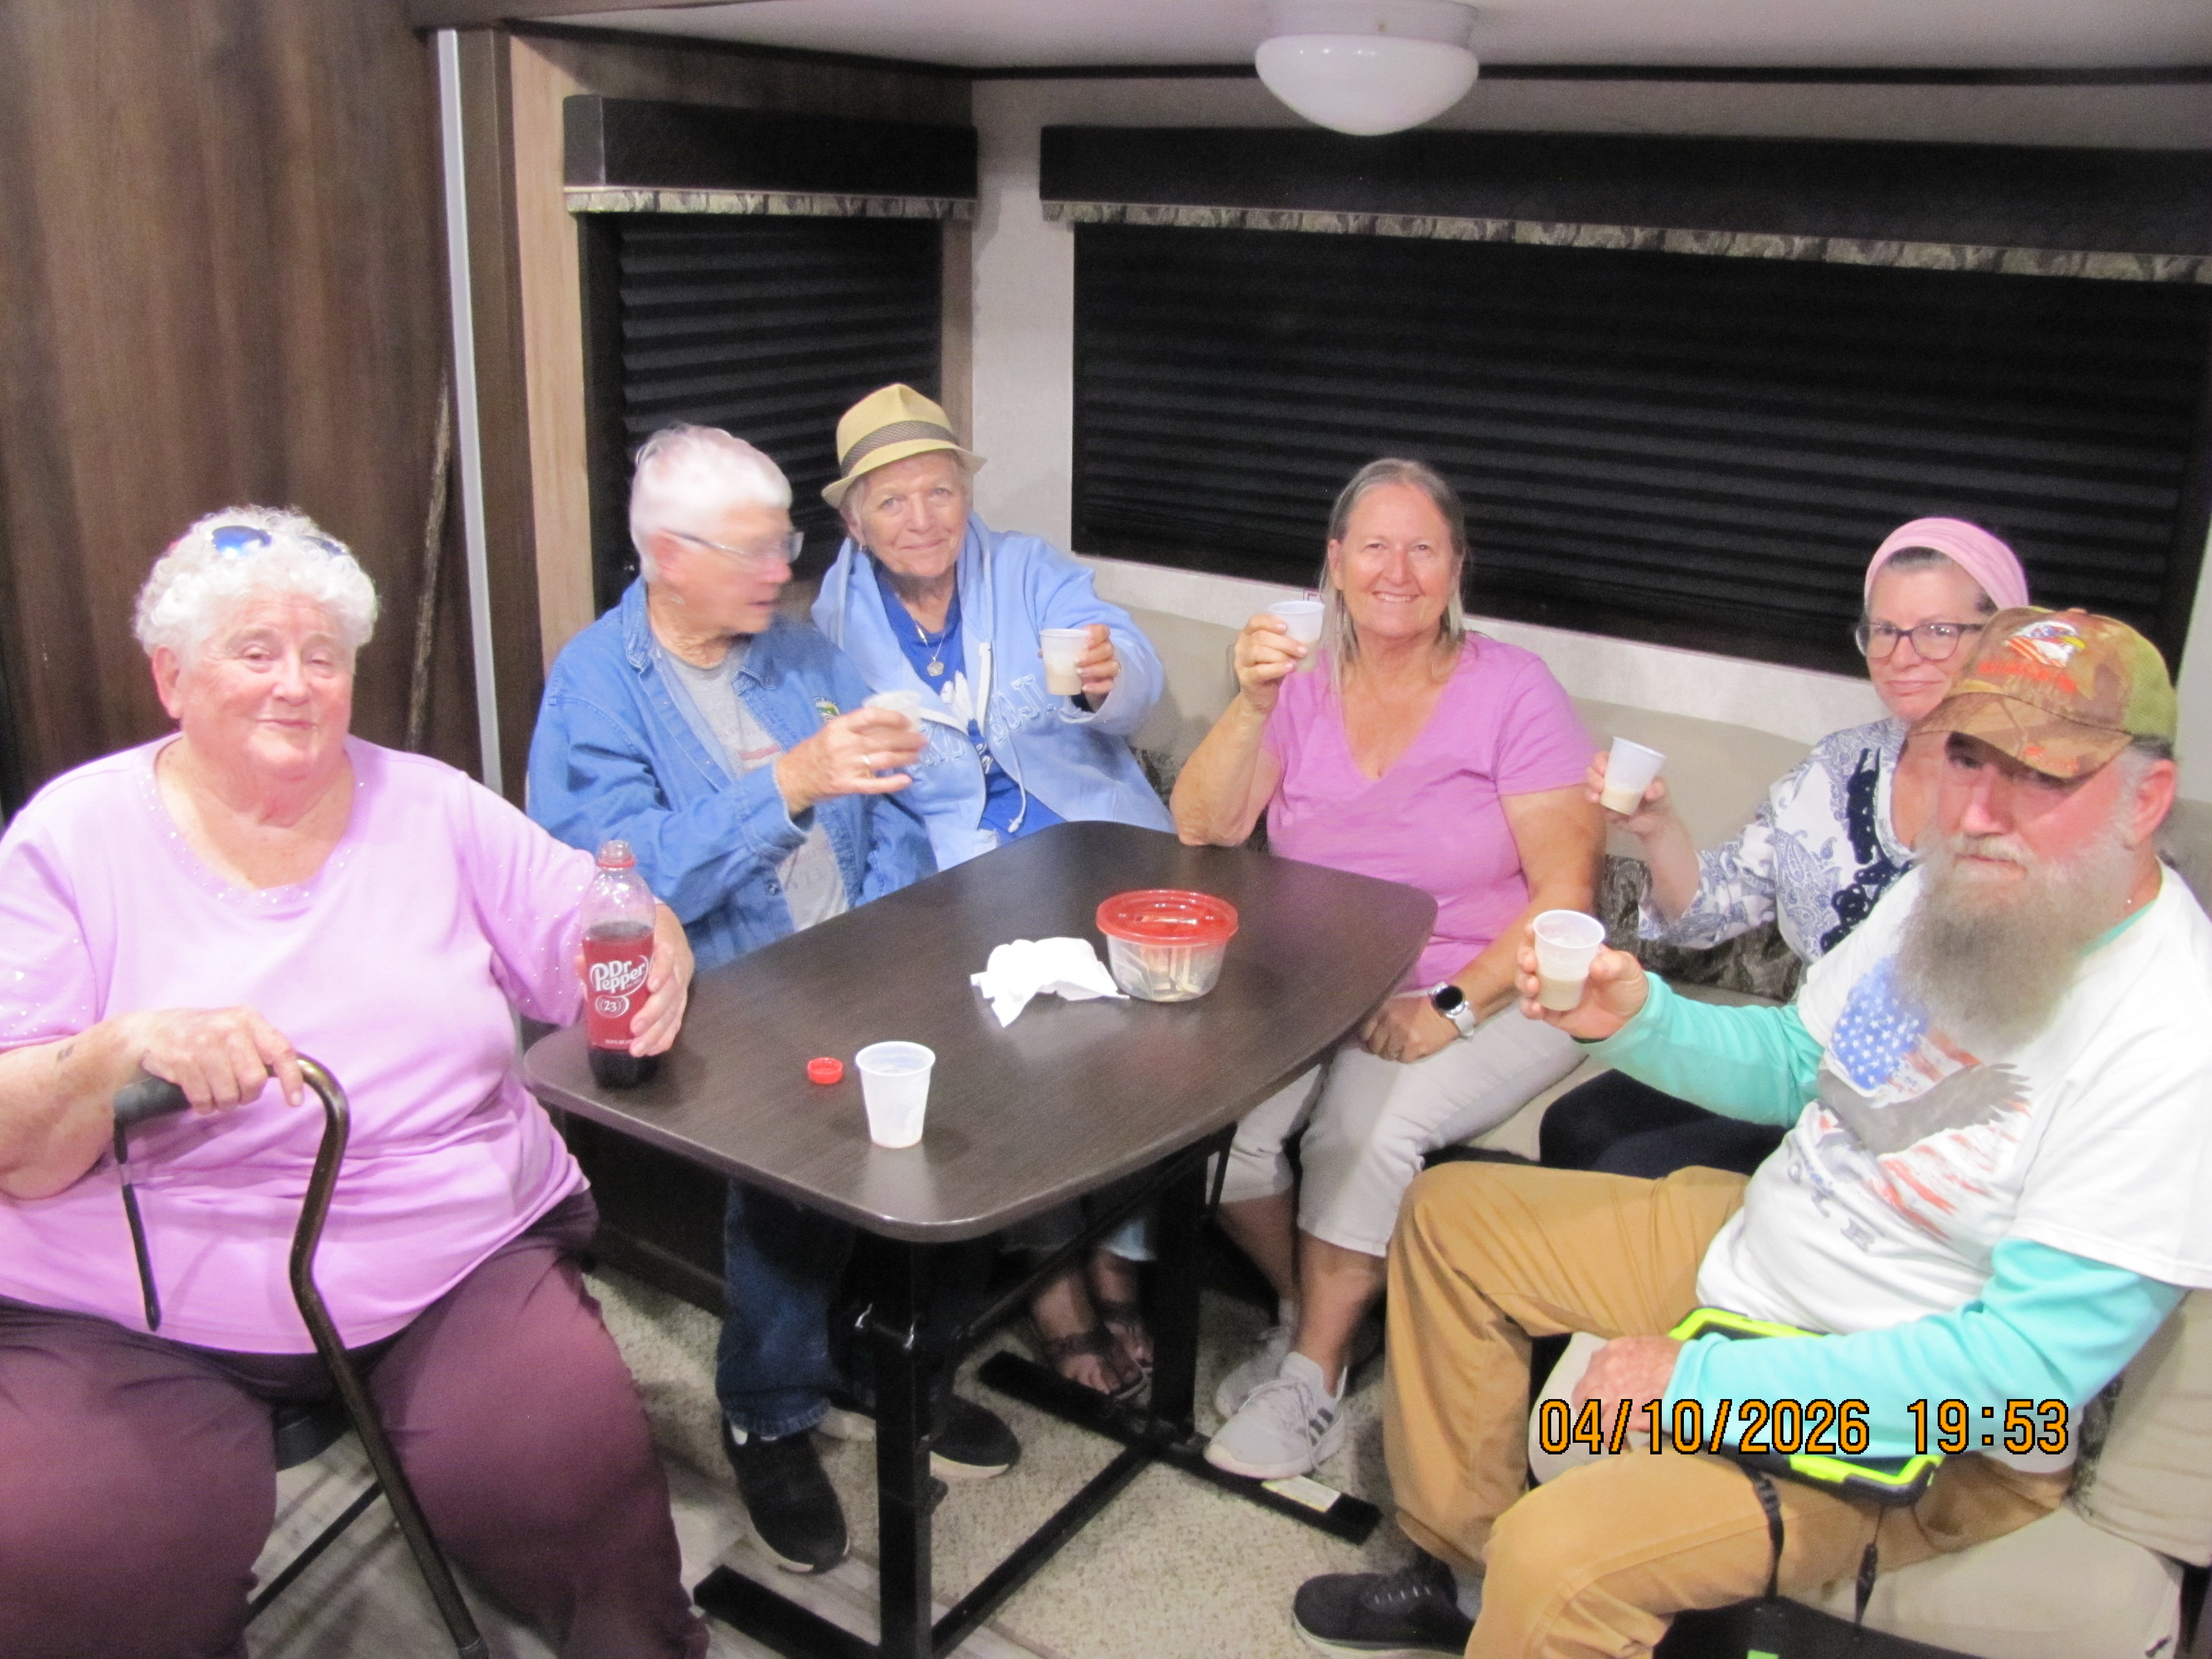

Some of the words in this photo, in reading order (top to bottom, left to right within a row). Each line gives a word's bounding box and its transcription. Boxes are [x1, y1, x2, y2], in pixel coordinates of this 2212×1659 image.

[609, 960, 632, 978] Dr
[591, 963, 645, 994] Pepper
[604, 1000, 618, 1013] 23
